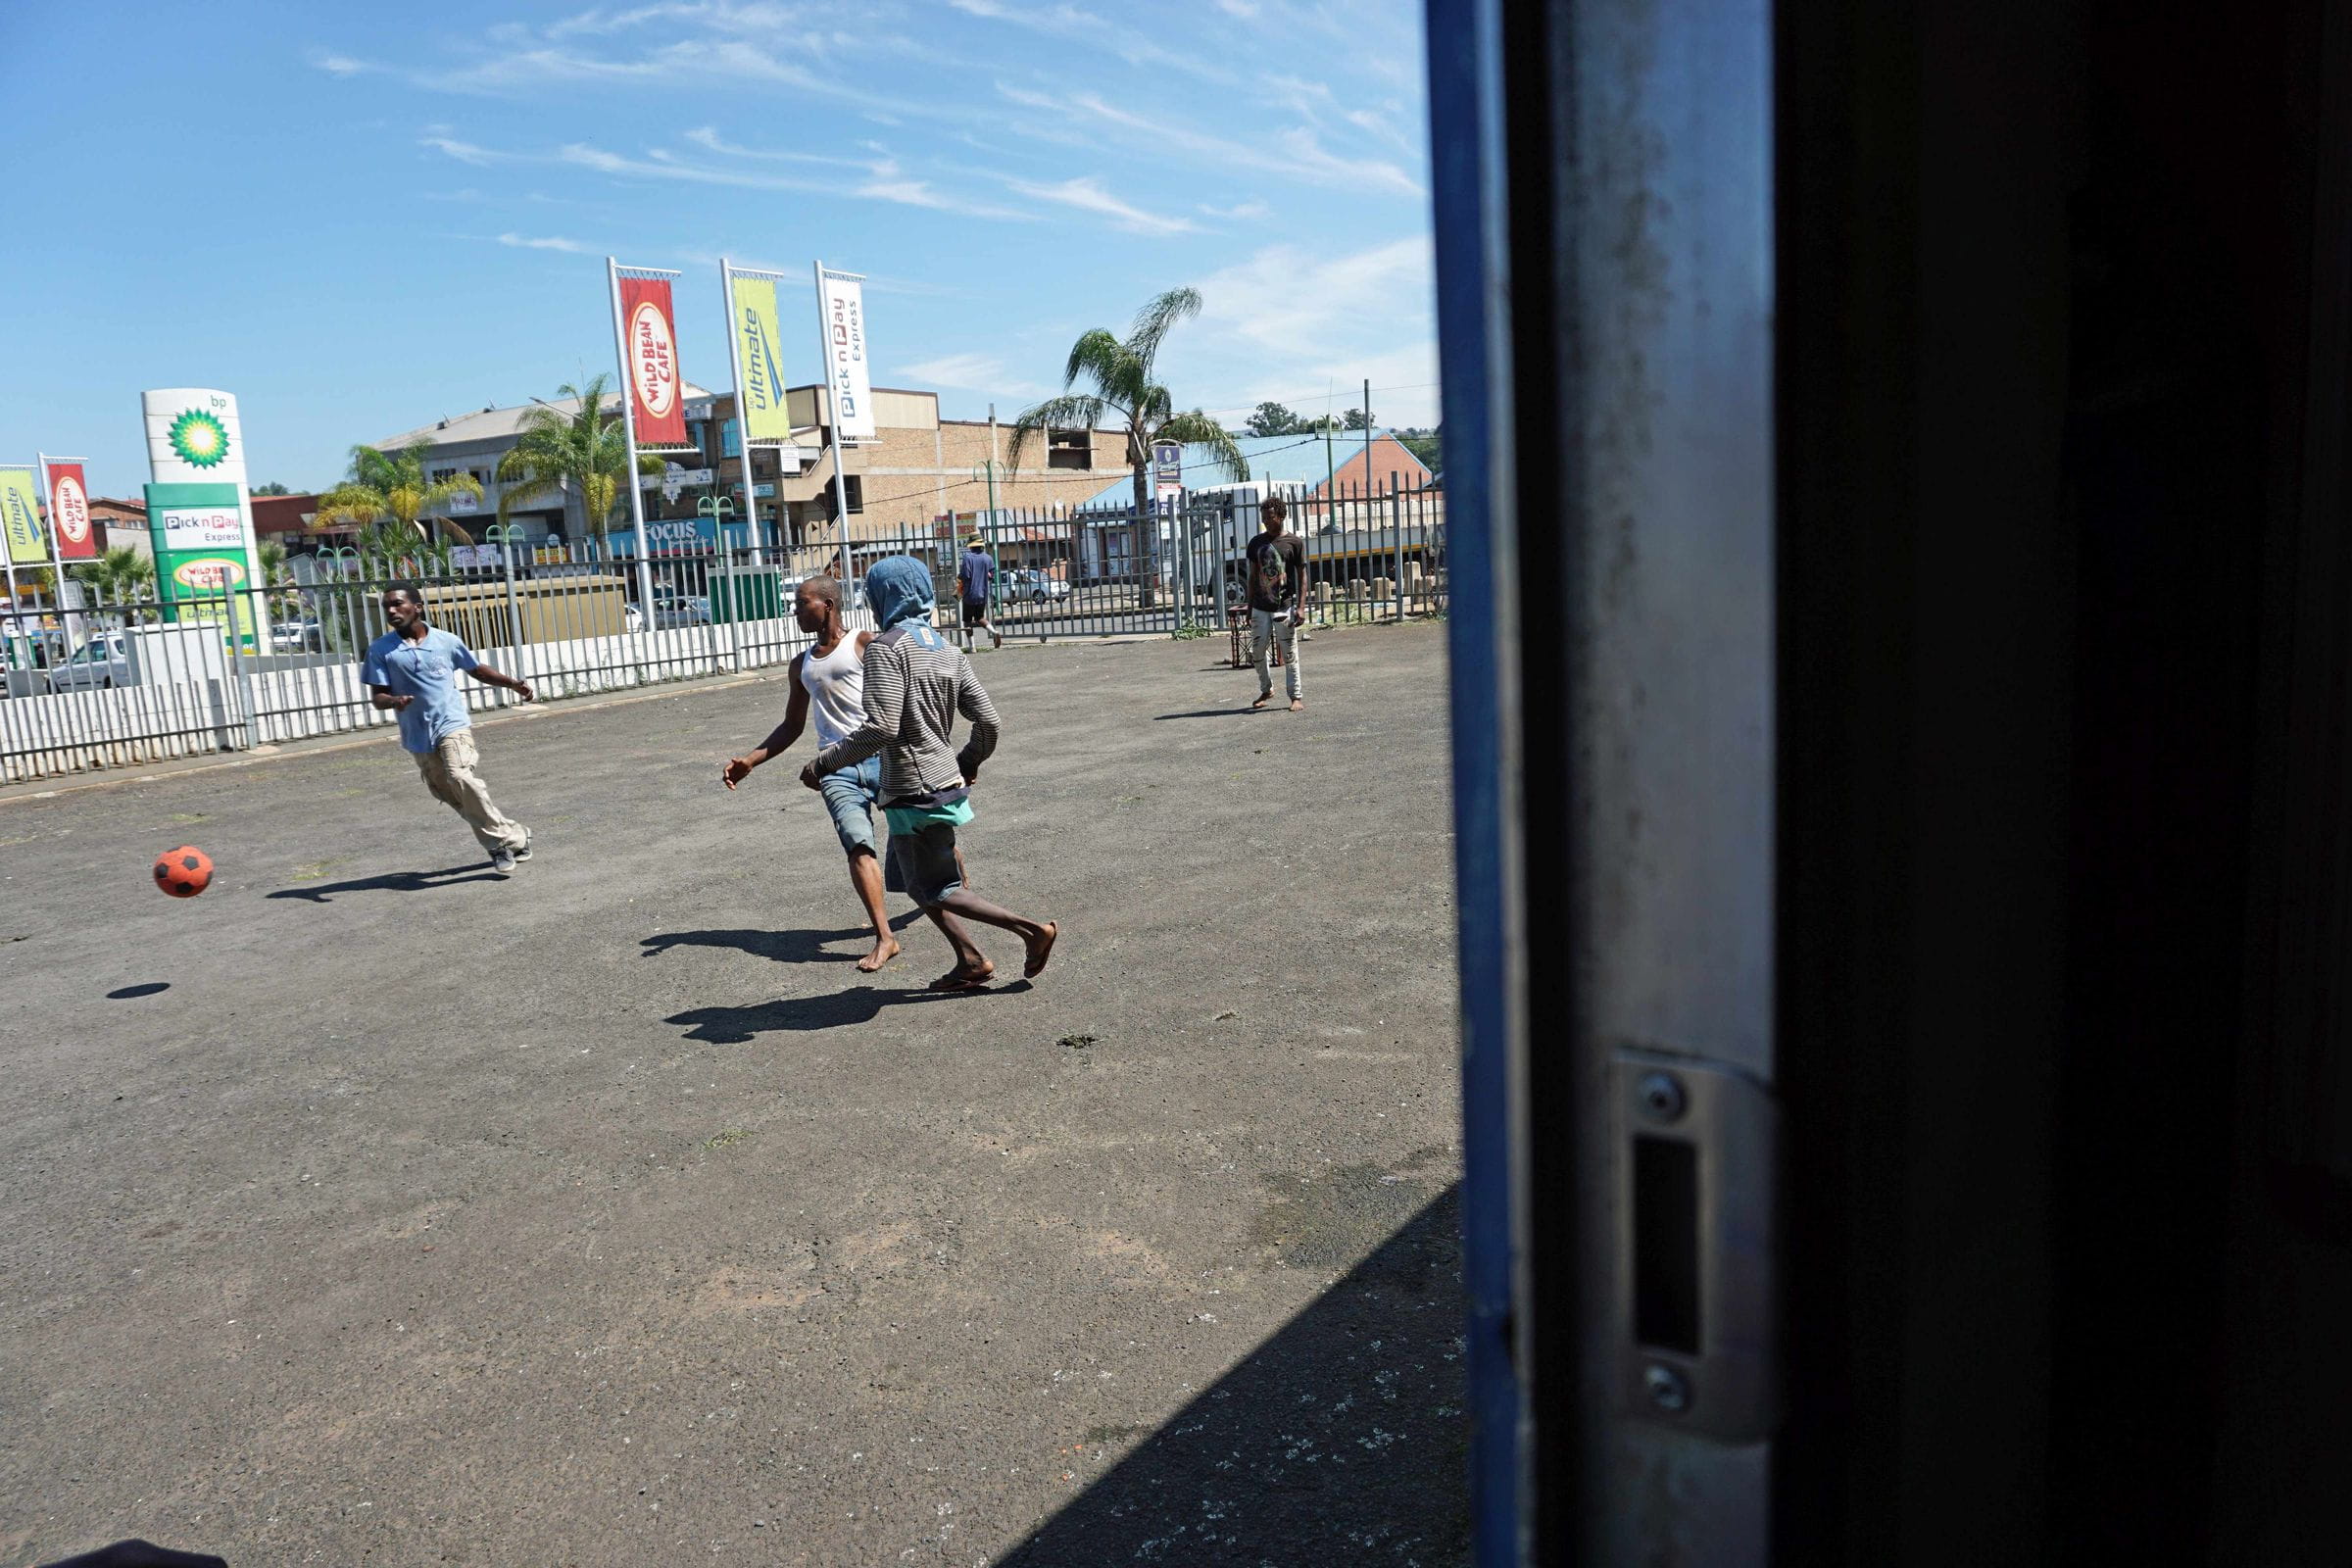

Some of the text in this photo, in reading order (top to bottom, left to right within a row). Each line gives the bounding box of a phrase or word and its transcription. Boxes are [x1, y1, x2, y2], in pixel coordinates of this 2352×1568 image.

[639, 320, 656, 360] BEAN
[850, 300, 861, 362] Express
[744, 307, 766, 411] ultimate
[833, 298, 856, 417] Pick n Pay
[210, 394, 227, 411] bp
[7, 486, 26, 546] ultimate
[62, 487, 74, 510] BEAN
[165, 514, 240, 530] Pick n Pay
[204, 532, 242, 543] Express
